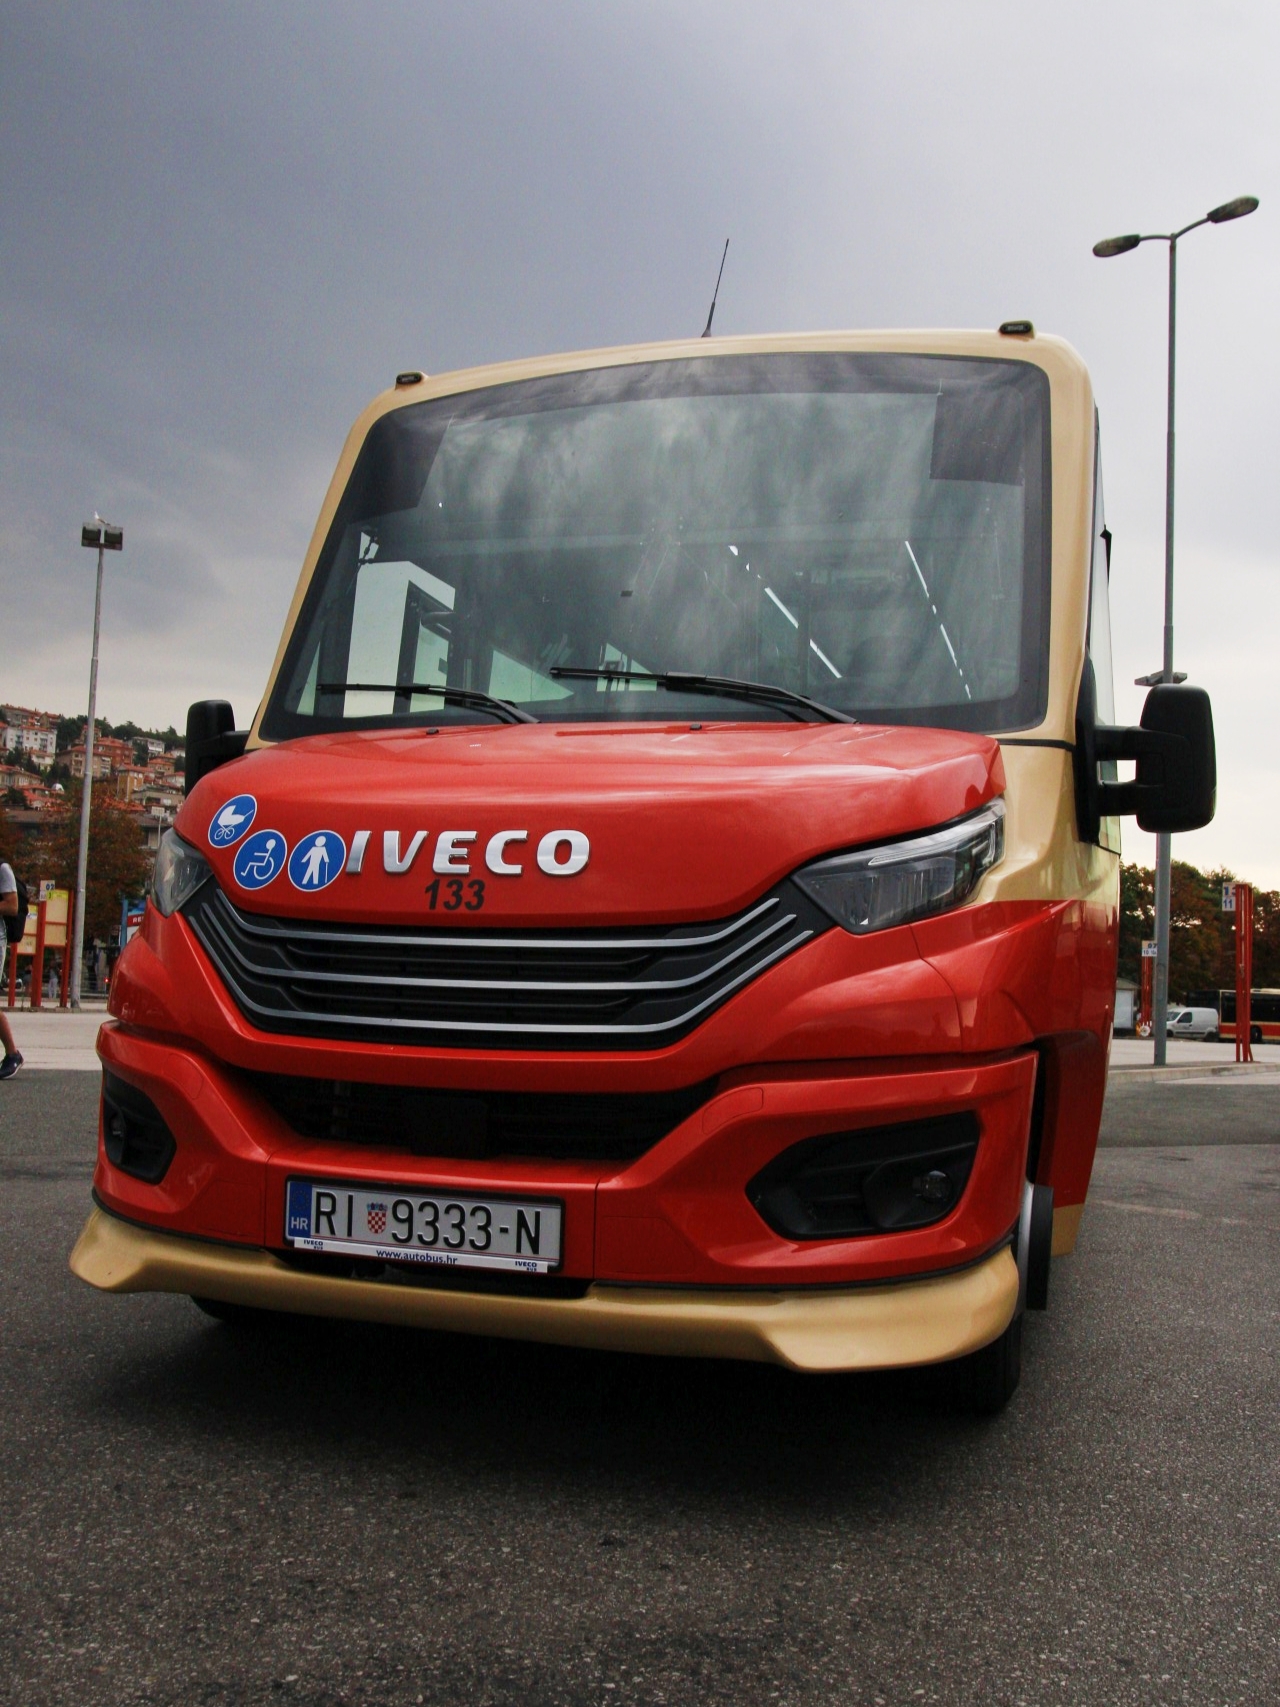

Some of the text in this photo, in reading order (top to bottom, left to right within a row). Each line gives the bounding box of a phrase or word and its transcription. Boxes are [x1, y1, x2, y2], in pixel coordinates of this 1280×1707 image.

[346, 830, 590, 876] IVECO
[425, 880, 486, 911] 133
[1223, 899, 1232, 908] 11
[291, 1217, 308, 1231] HR
[314, 1191, 541, 1255] RI 9333-N
[376, 1248, 458, 1265] www.autobus.hr
